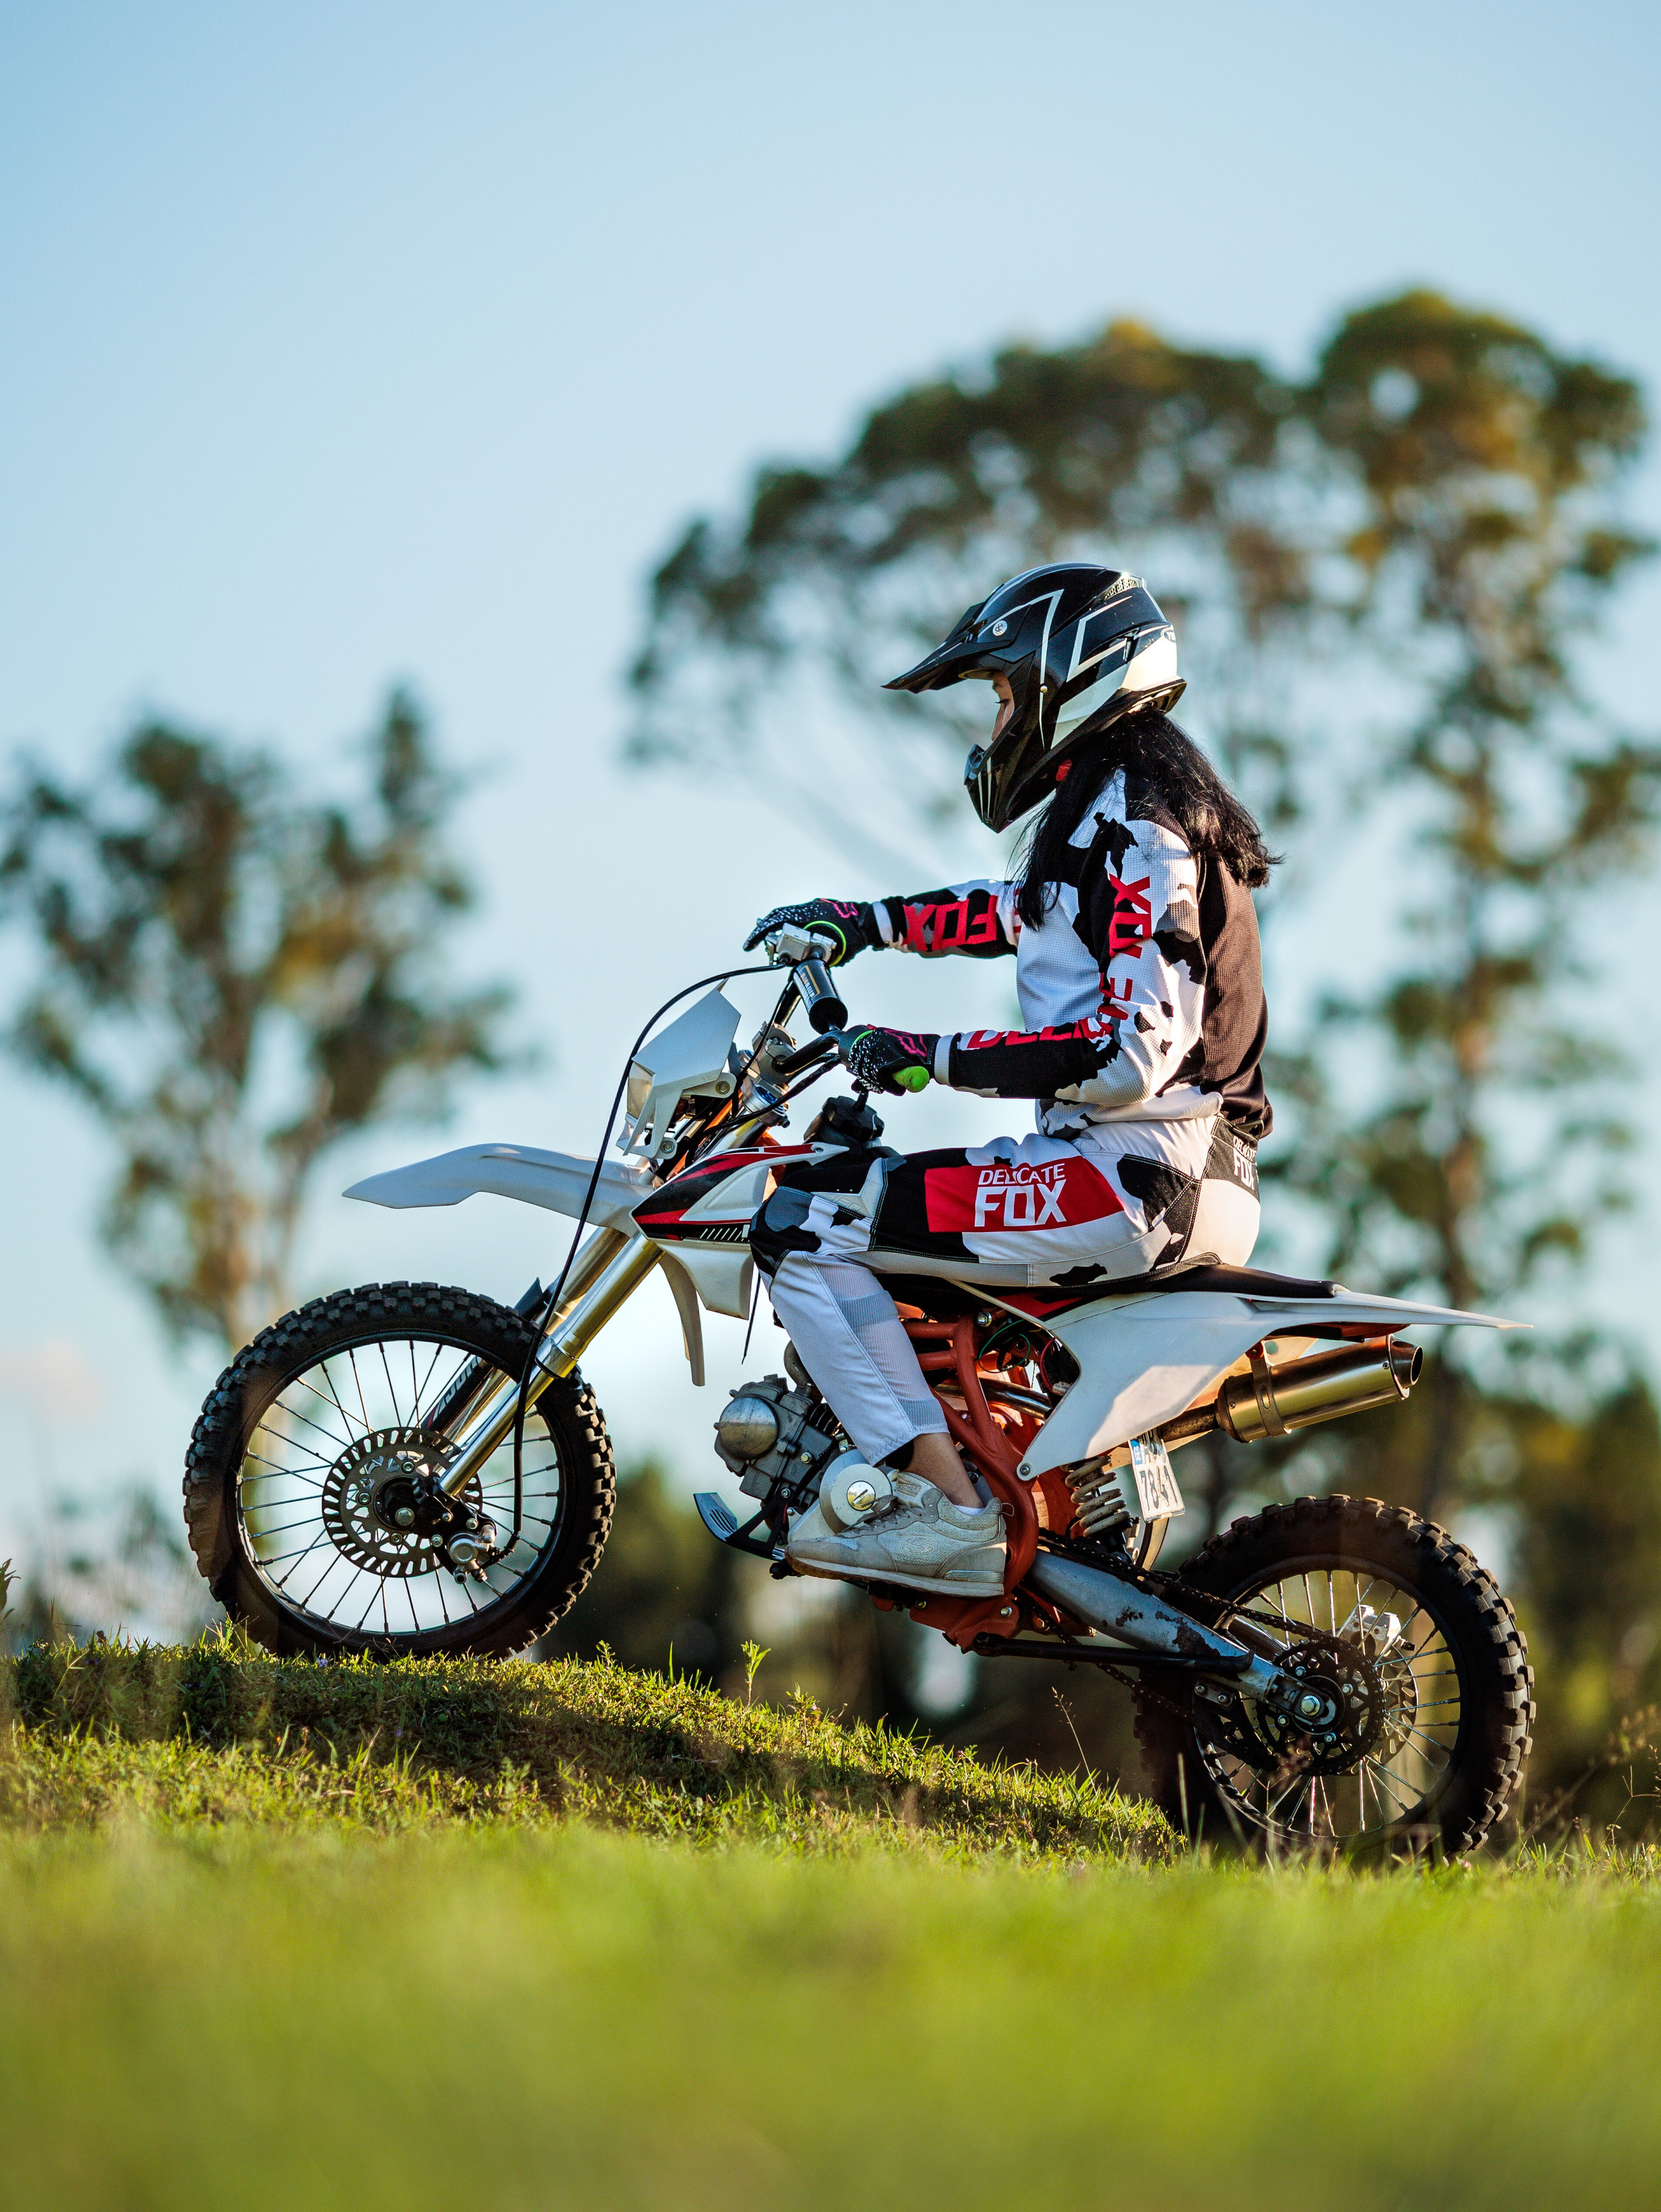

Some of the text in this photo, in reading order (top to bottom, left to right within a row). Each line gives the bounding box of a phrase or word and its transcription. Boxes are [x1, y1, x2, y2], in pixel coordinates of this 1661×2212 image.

[902, 895, 999, 952] FOX
[1233, 1135, 1257, 1162] DELICATE
[1233, 1148, 1255, 1190] FOX
[978, 1163, 1065, 1186] DELICATE
[974, 1179, 1067, 1227] FOX
